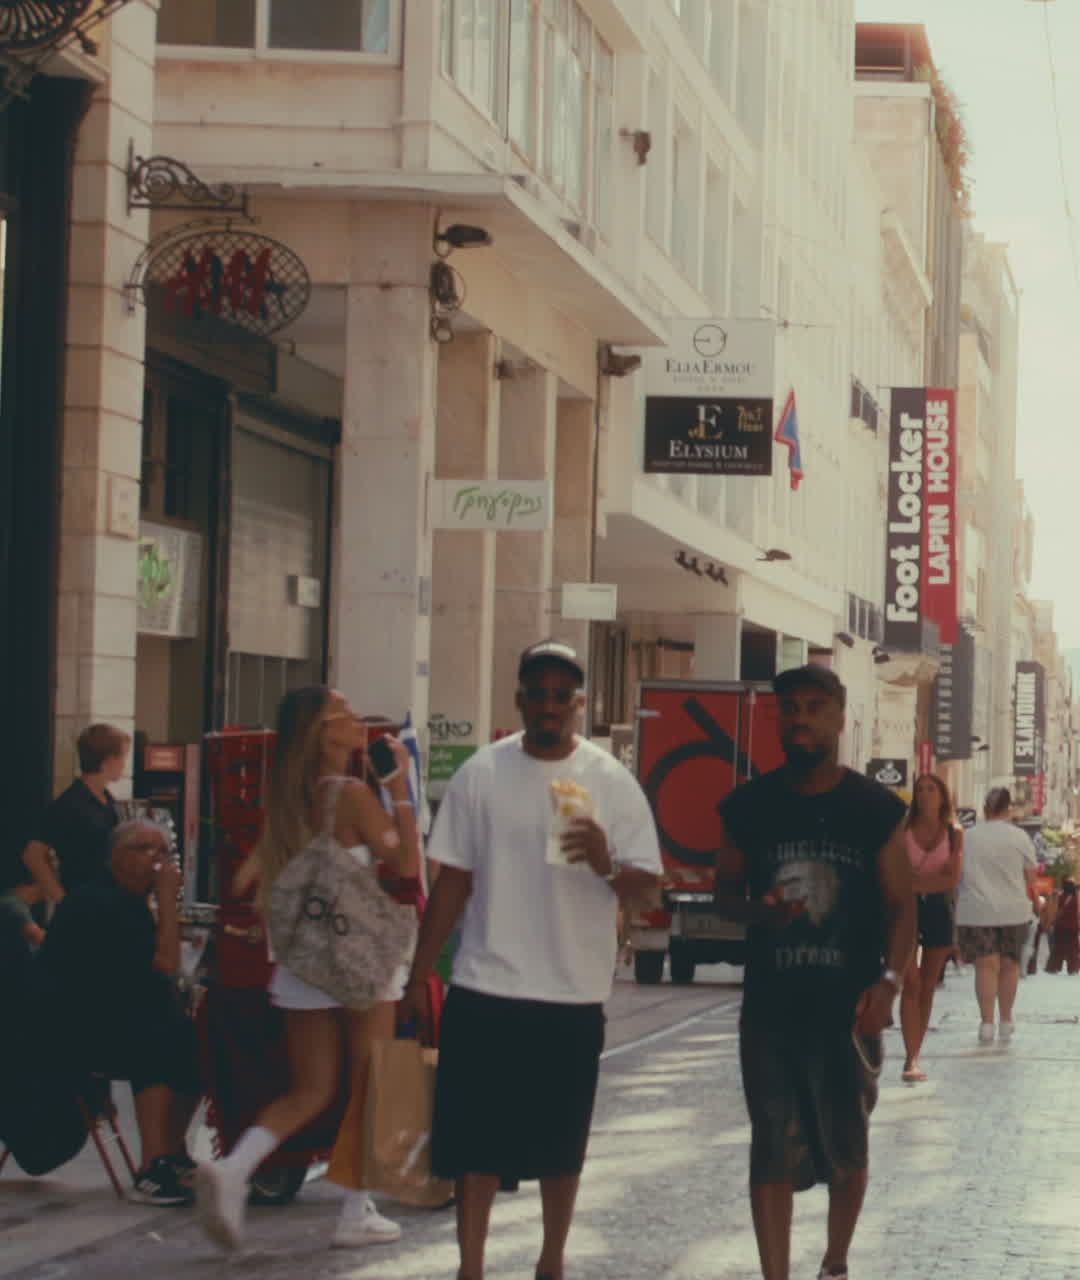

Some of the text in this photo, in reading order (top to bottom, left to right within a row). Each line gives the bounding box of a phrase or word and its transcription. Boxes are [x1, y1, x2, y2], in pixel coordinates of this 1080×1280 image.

[889, 411, 924, 534] Locker
[926, 399, 950, 493] HOUSE
[886, 544, 920, 623] Foot
[927, 504, 951, 586] LAPIN
